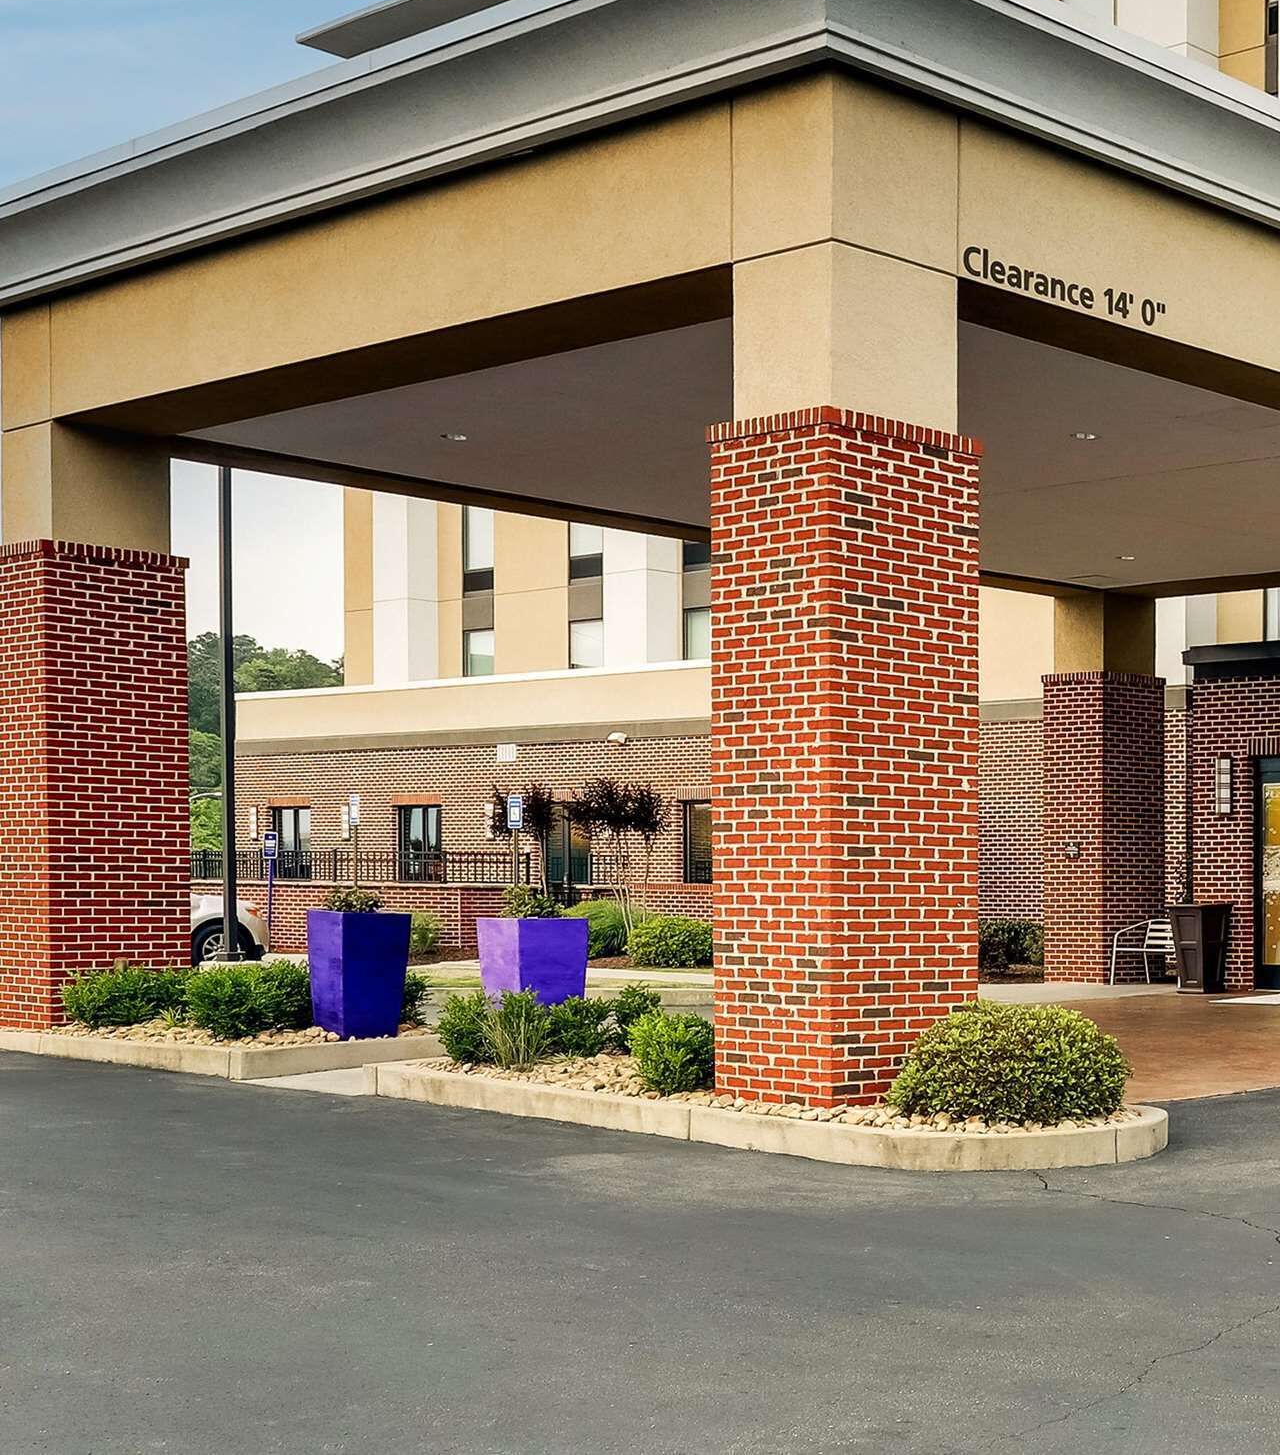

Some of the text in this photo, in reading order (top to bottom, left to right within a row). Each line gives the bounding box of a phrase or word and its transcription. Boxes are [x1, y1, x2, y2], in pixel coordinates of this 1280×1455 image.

[963, 246, 1166, 326] Clearance 14' 0"
